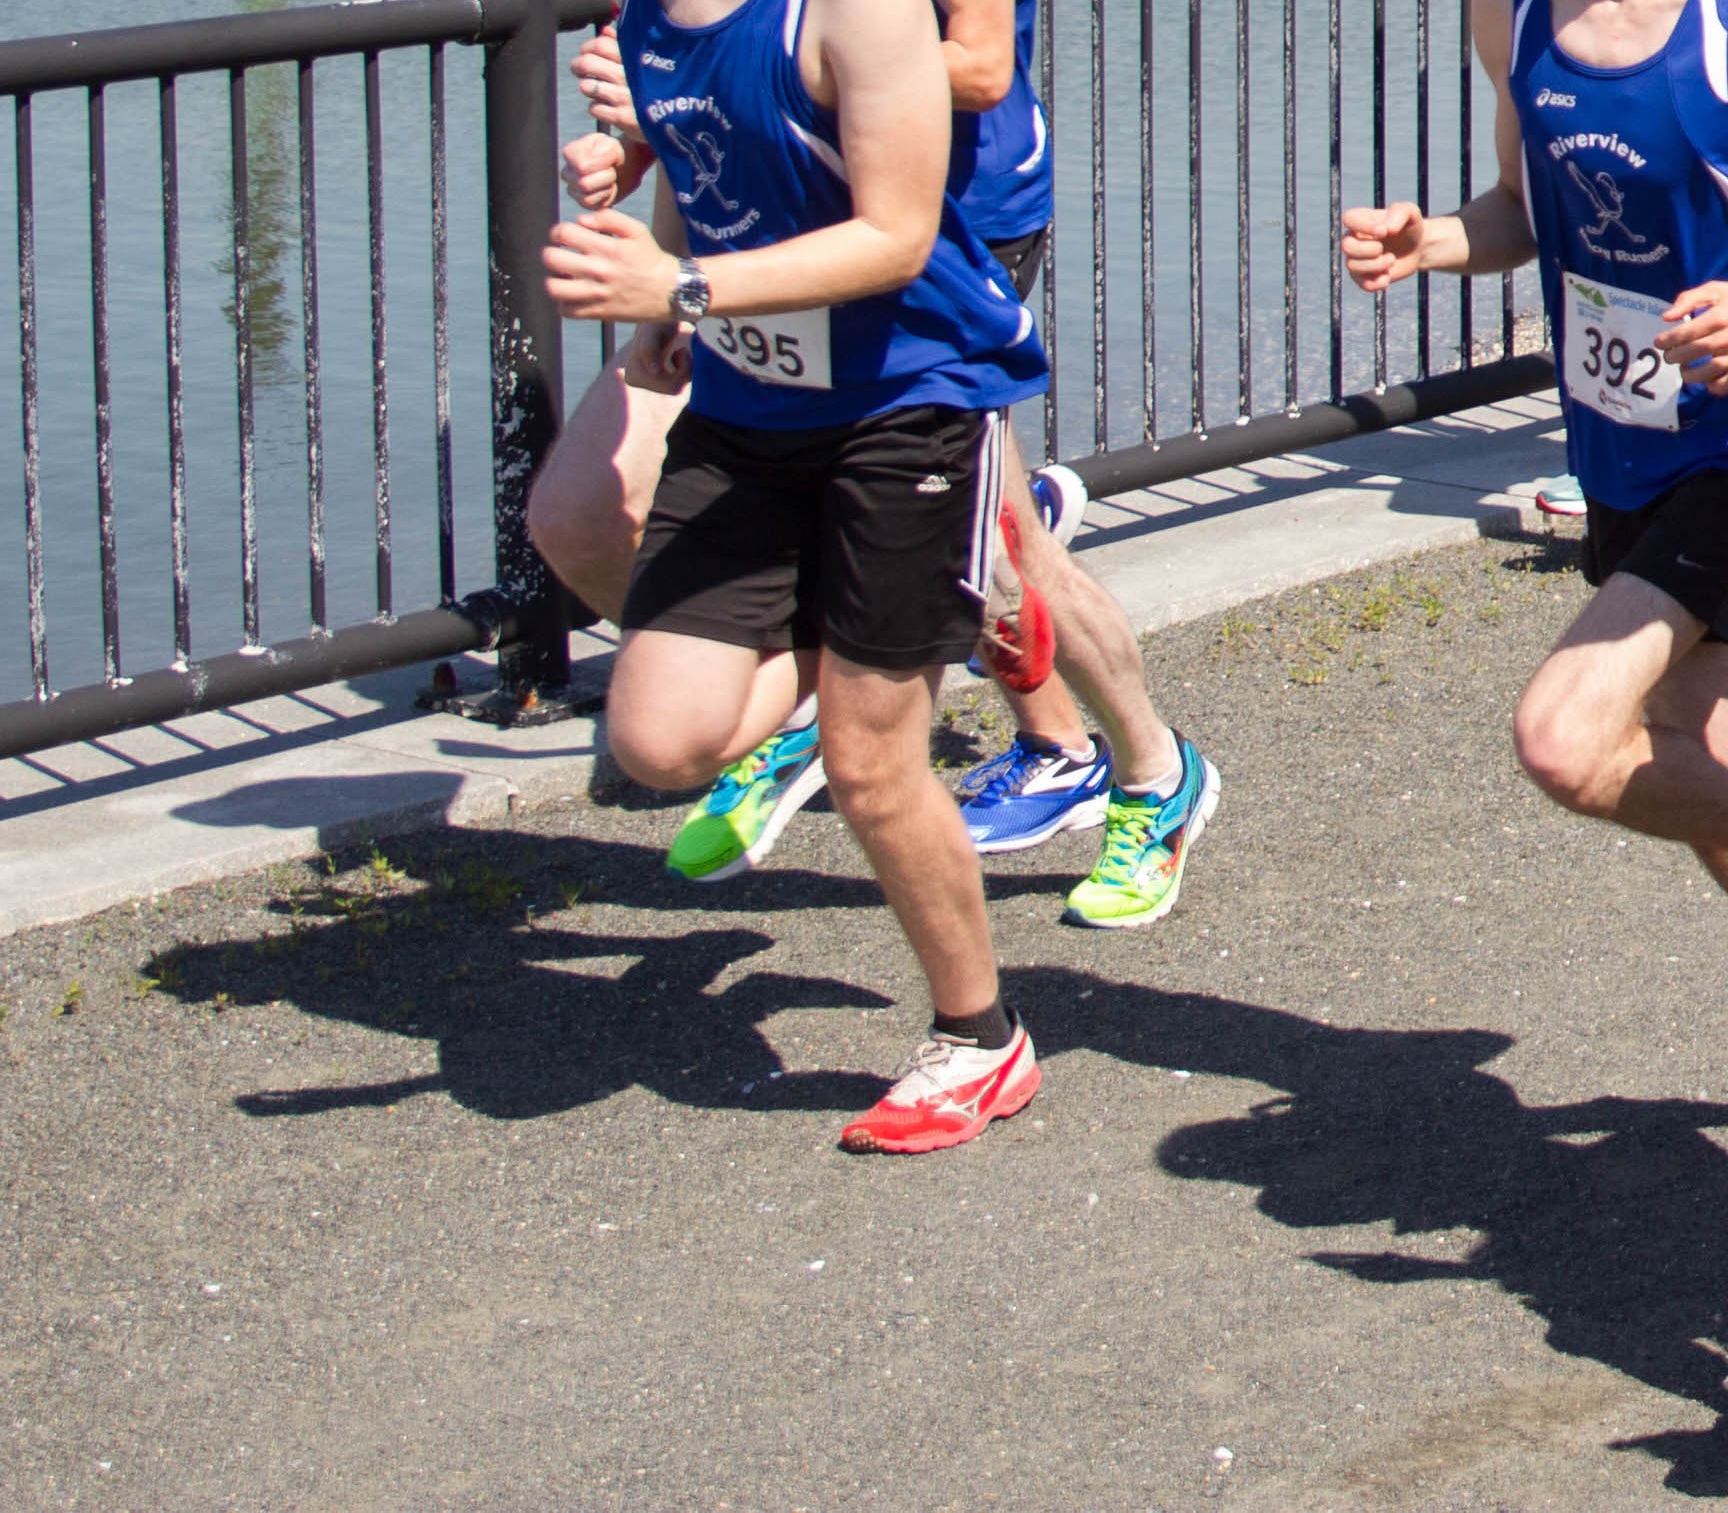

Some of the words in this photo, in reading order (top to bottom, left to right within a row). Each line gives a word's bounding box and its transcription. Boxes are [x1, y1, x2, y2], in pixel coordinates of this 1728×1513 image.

[1549, 92, 1577, 108] asics
[1548, 132, 1647, 169] Riverview
[1614, 243, 1671, 265] Runners
[716, 316, 805, 378] 395
[1582, 326, 1662, 401] 392
